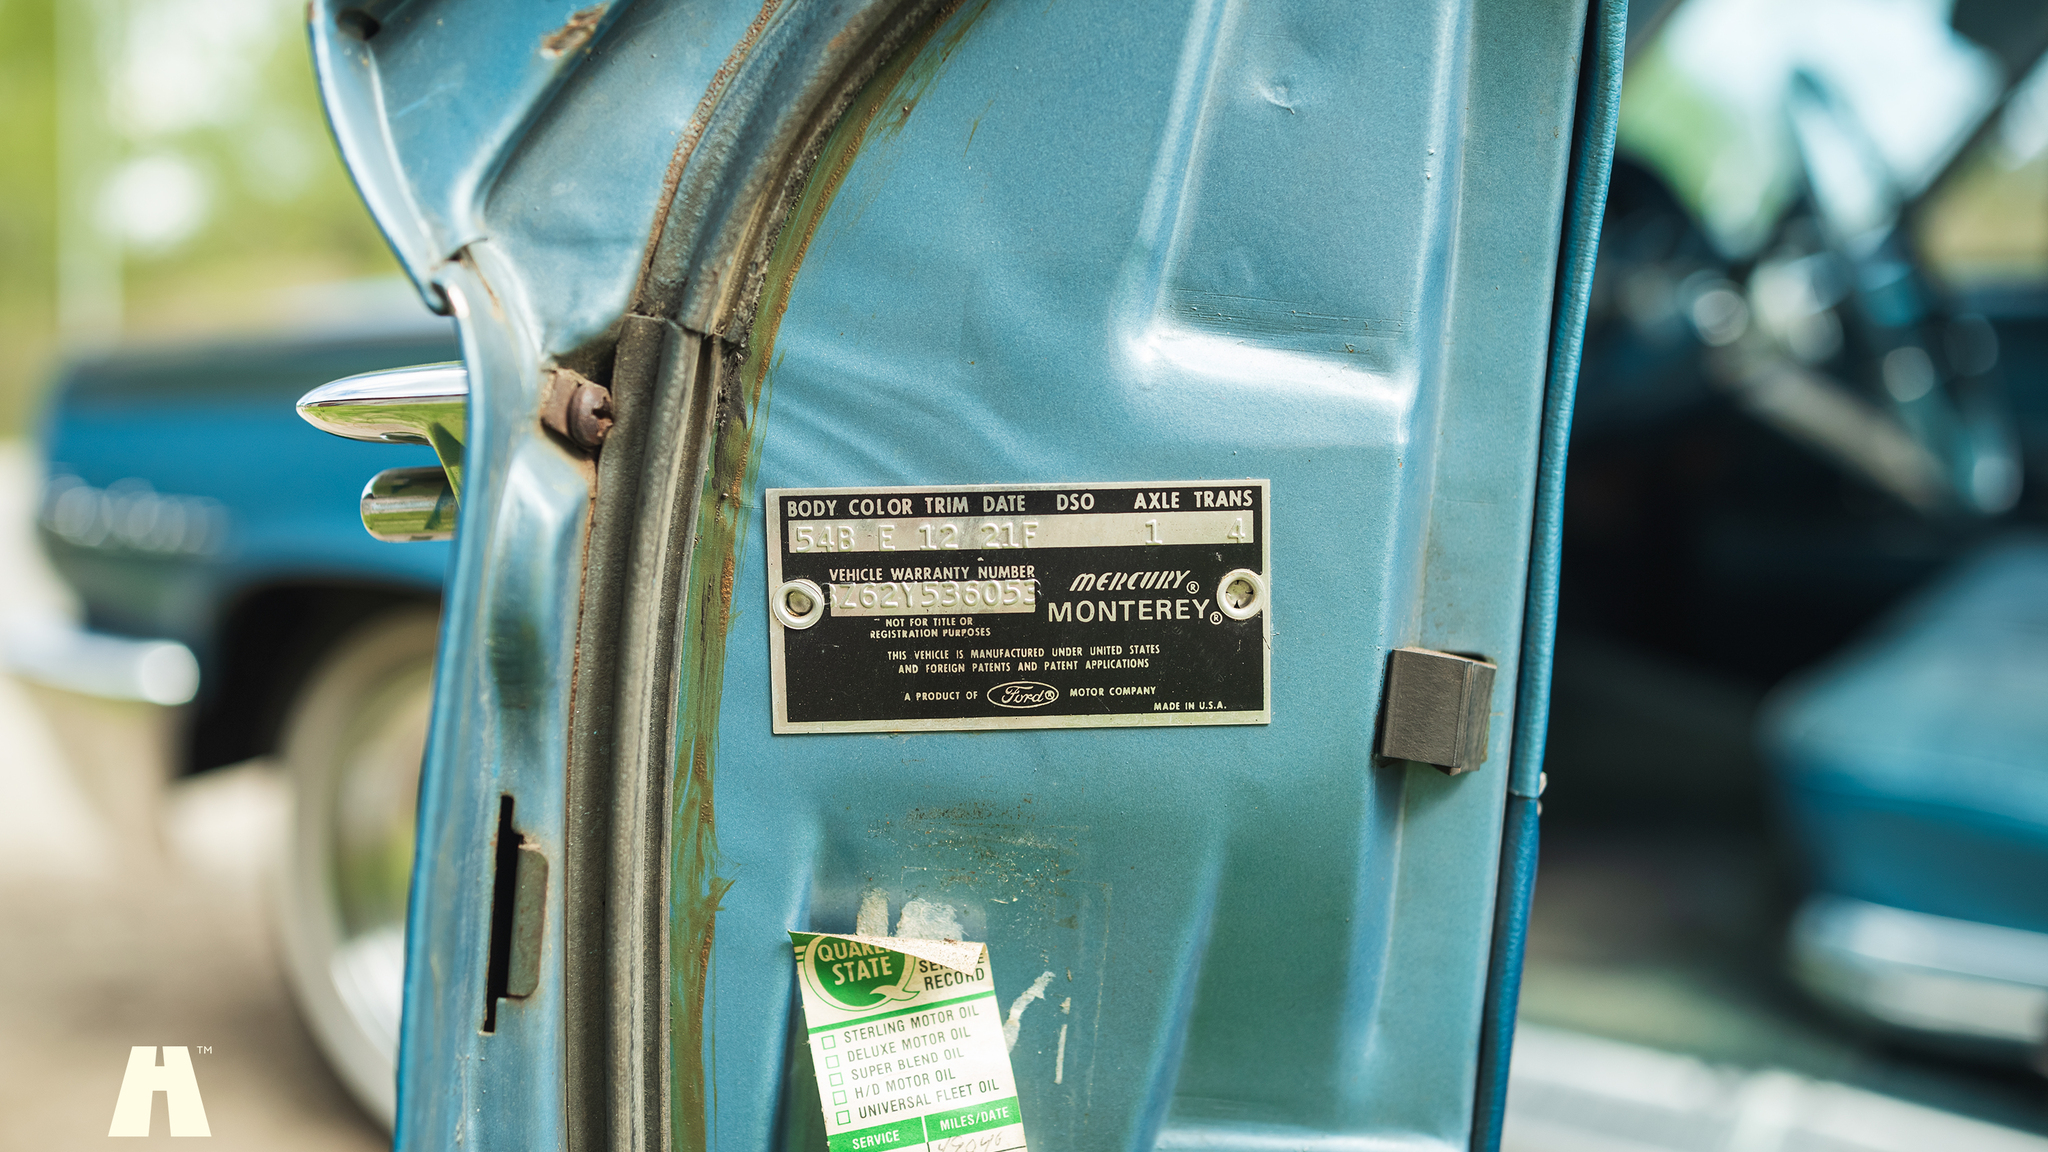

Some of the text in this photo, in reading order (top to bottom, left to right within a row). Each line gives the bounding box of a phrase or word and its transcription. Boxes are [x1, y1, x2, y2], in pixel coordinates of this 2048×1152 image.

[787, 490, 1253, 517] BODY COLOR TRIM DATE DSO AXLE TRANS
[796, 517, 1246, 553] 54B E 12 21F 1 4
[829, 565, 1035, 581] VEHICLE WARRANTY NUMBER
[1069, 570, 1190, 592] MERCURY
[885, 616, 973, 627] NOT FOR TITLE OR
[1048, 599, 1210, 623] MONTEREY
[870, 627, 991, 639] REGISTRATION PURPOSES
[887, 644, 1160, 660] THIS VEHICLE IS MANUFACTURED UNDER UNITED STATES
[898, 658, 1149, 674] AND FOREIGN PATENTS AND PATENT APPLICATIONS
[904, 692, 911, 701] A
[916, 691, 960, 701] PRODUCT
[965, 690, 978, 700] OF
[1001, 685, 1045, 704] Ford
[1069, 687, 1105, 697] MOTOR
[1109, 686, 1156, 696] COMPANY
[1153, 700, 1227, 711] MADE IN U.S.A.
[817, 941, 891, 962] QUAK
[831, 956, 892, 986] STATE
[843, 1005, 979, 1043] STERLING MOTOR OIL
[847, 1026, 971, 1062] DELUXE MOTOR OIL
[851, 1047, 964, 1081] SUPER BLEND OIL
[855, 1068, 956, 1099] H/D MOTOR OIL
[858, 1079, 1000, 1119] UNIVERSAL FLEET OIL
[852, 1106, 1010, 1150] SERVICE MILES/DATE
